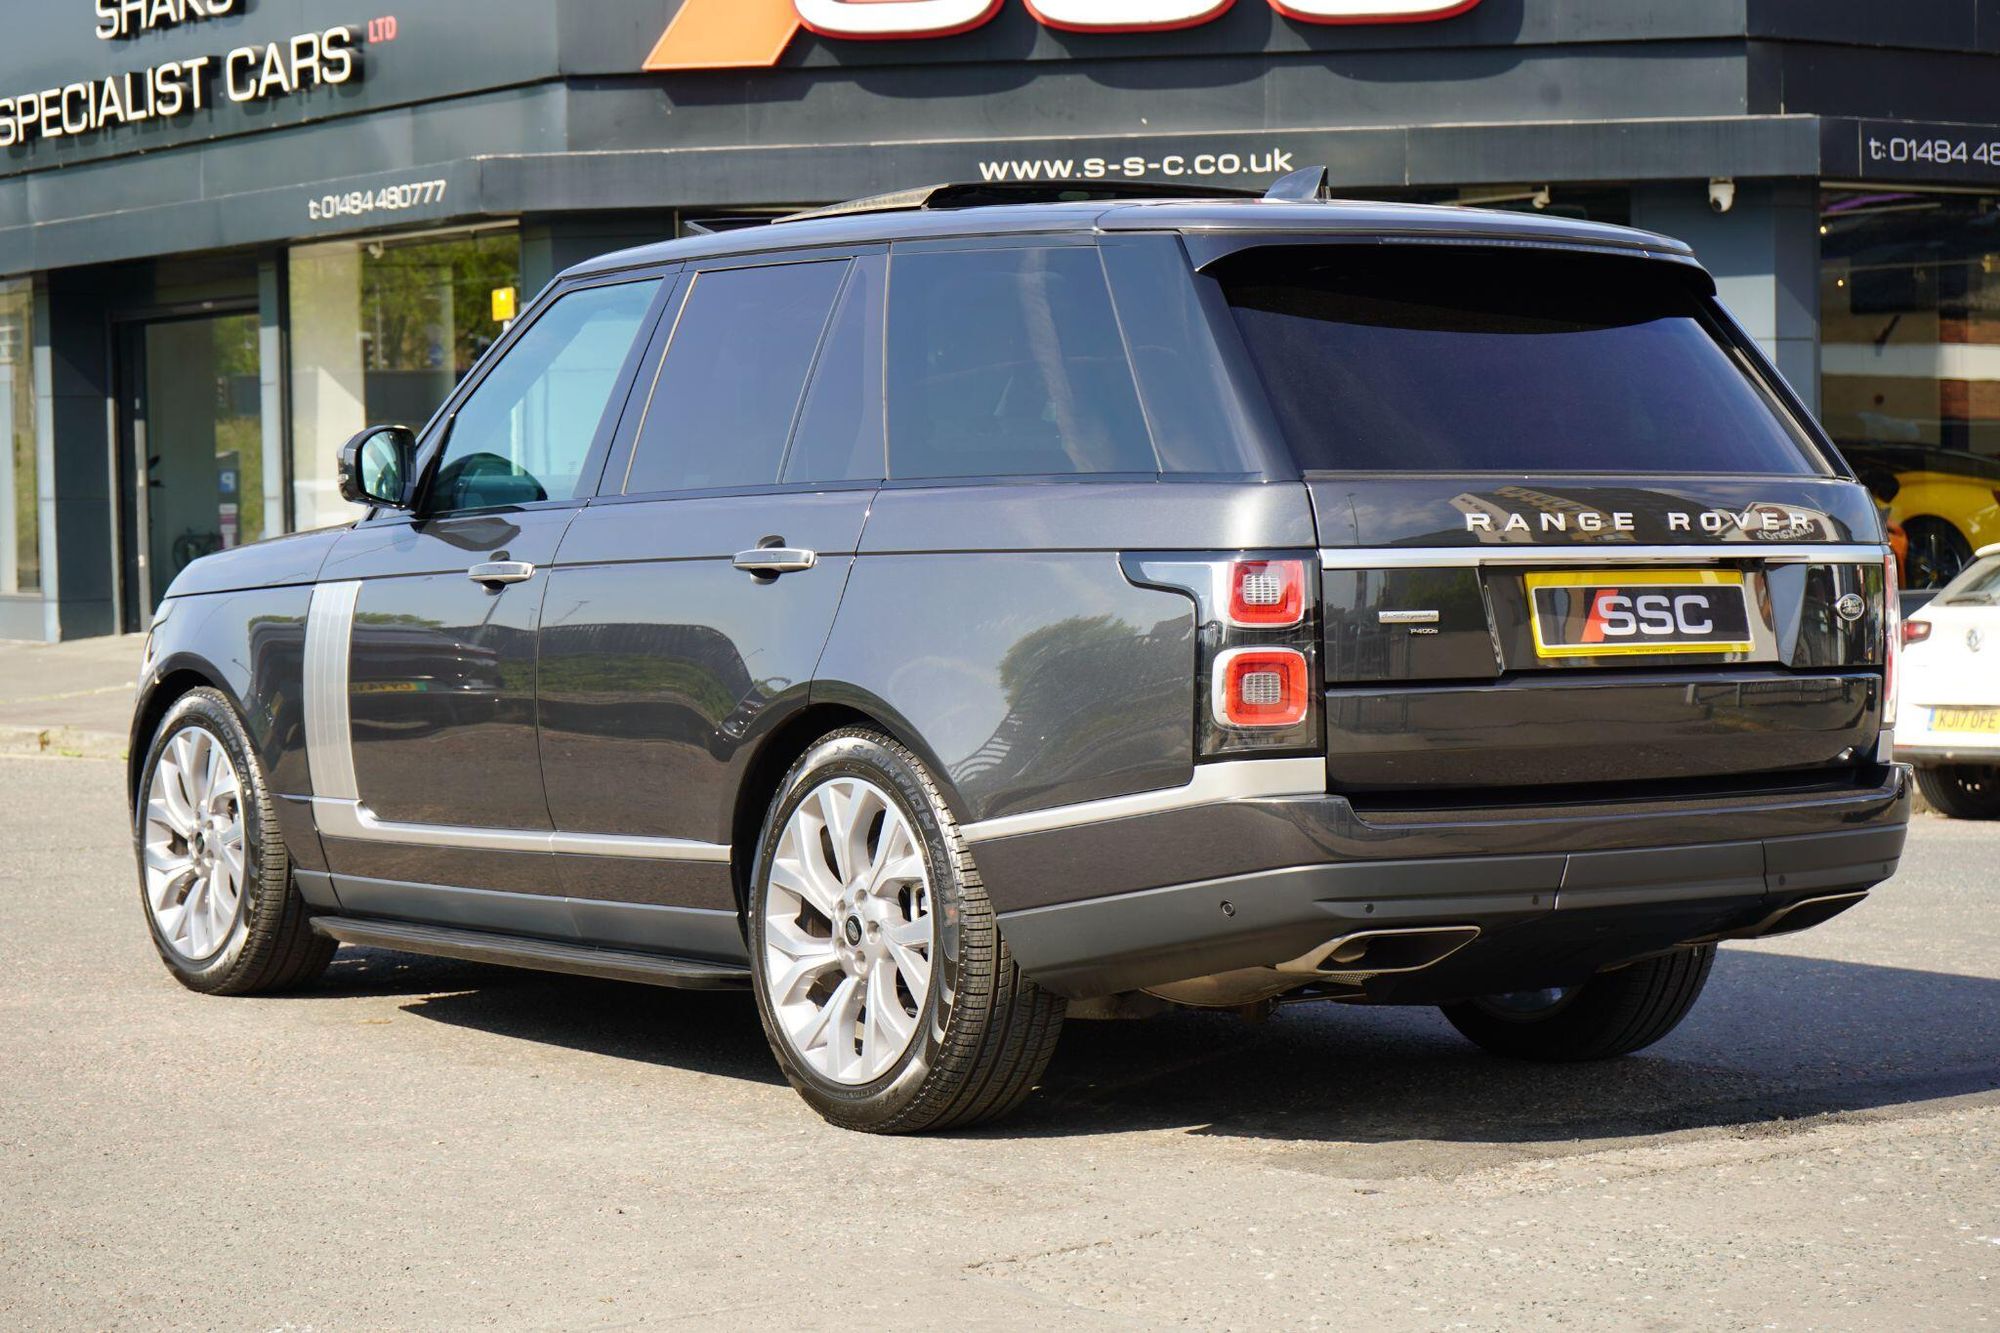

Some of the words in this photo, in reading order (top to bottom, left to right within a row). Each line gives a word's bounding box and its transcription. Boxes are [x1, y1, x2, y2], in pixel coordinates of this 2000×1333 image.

[95, 0, 233, 39] SHA
[0, 57, 209, 147] SPECIALIST
[226, 26, 352, 102] CARS
[368, 16, 397, 44] LTD
[978, 148, 1294, 181] www.s-s-c.co.uk
[374, 179, 447, 210] 480777
[1465, 511, 1635, 532] RANGE
[1667, 511, 1812, 532] ROVER
[1597, 595, 1713, 636] SSC
